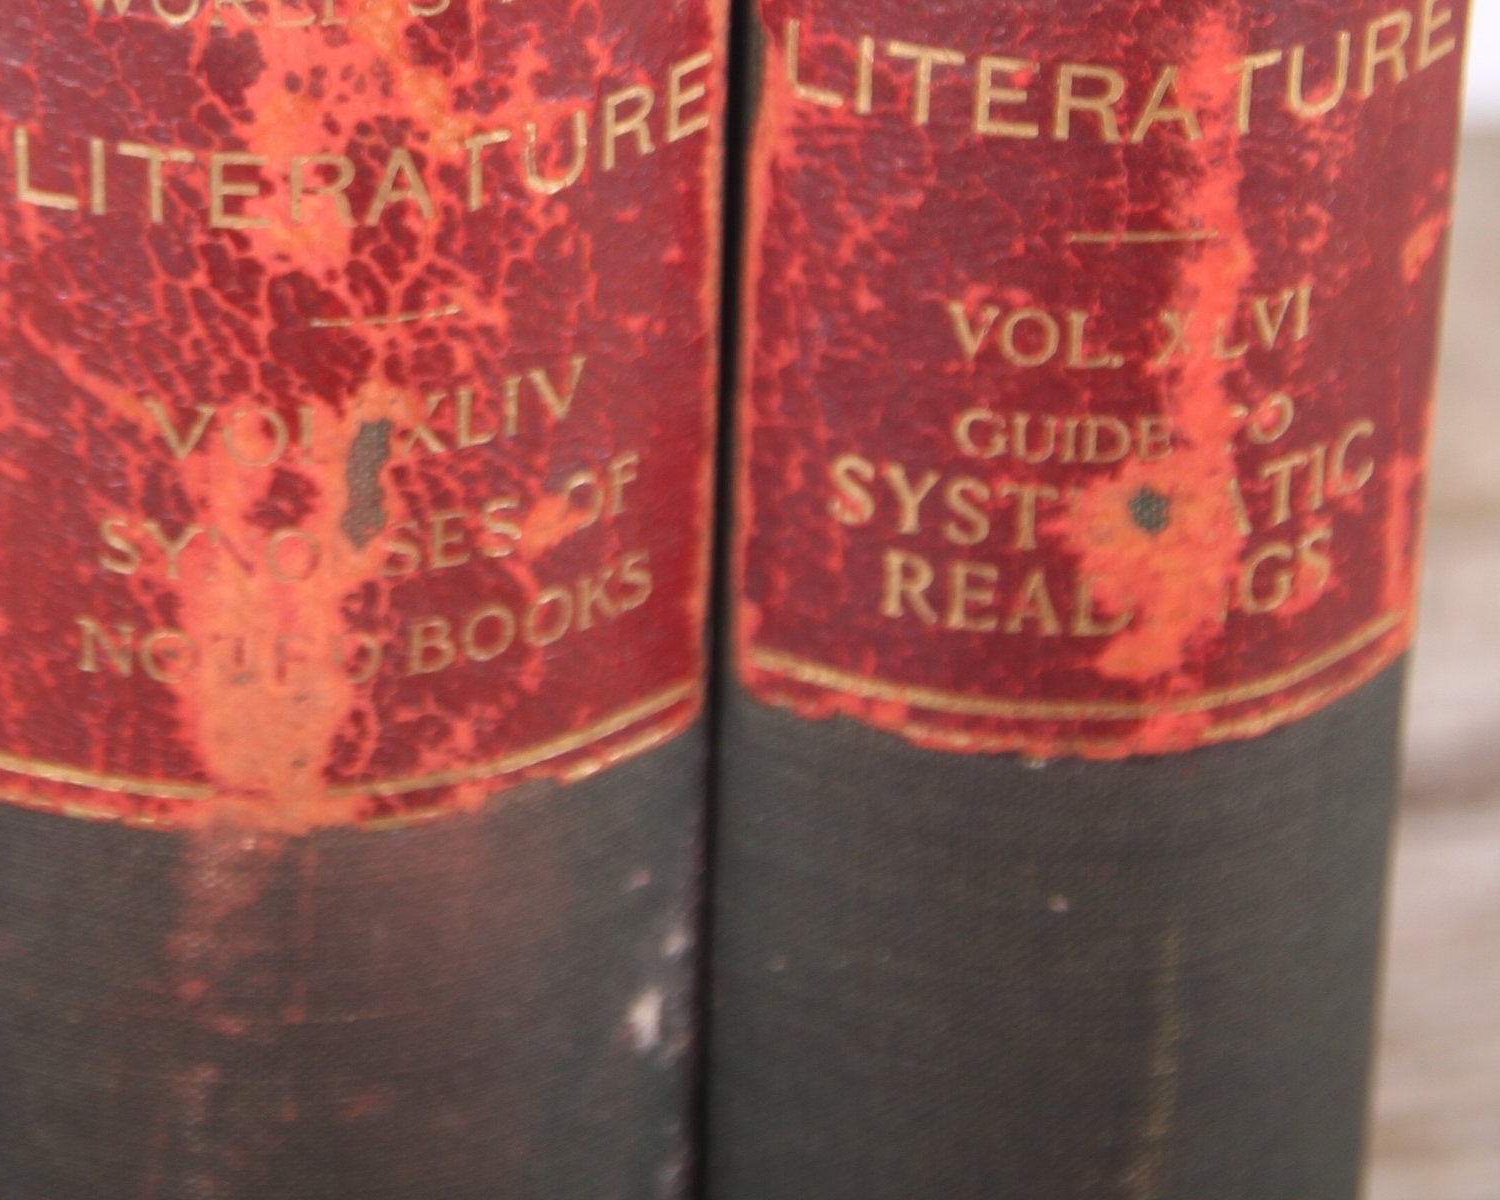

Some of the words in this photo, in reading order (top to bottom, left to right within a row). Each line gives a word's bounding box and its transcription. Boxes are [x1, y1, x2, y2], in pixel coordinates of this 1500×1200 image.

[15, 52, 713, 230] LITERATURE
[947, 299, 1126, 370] VOL.
[1153, 285, 1313, 368] XLVI
[827, 418, 1376, 551] SYSTTIC
[953, 407, 1176, 464] GUIDE
[100, 499, 522, 583] SYOSES
[882, 528, 1333, 638] READGS
[407, 555, 654, 678] BOOKS
